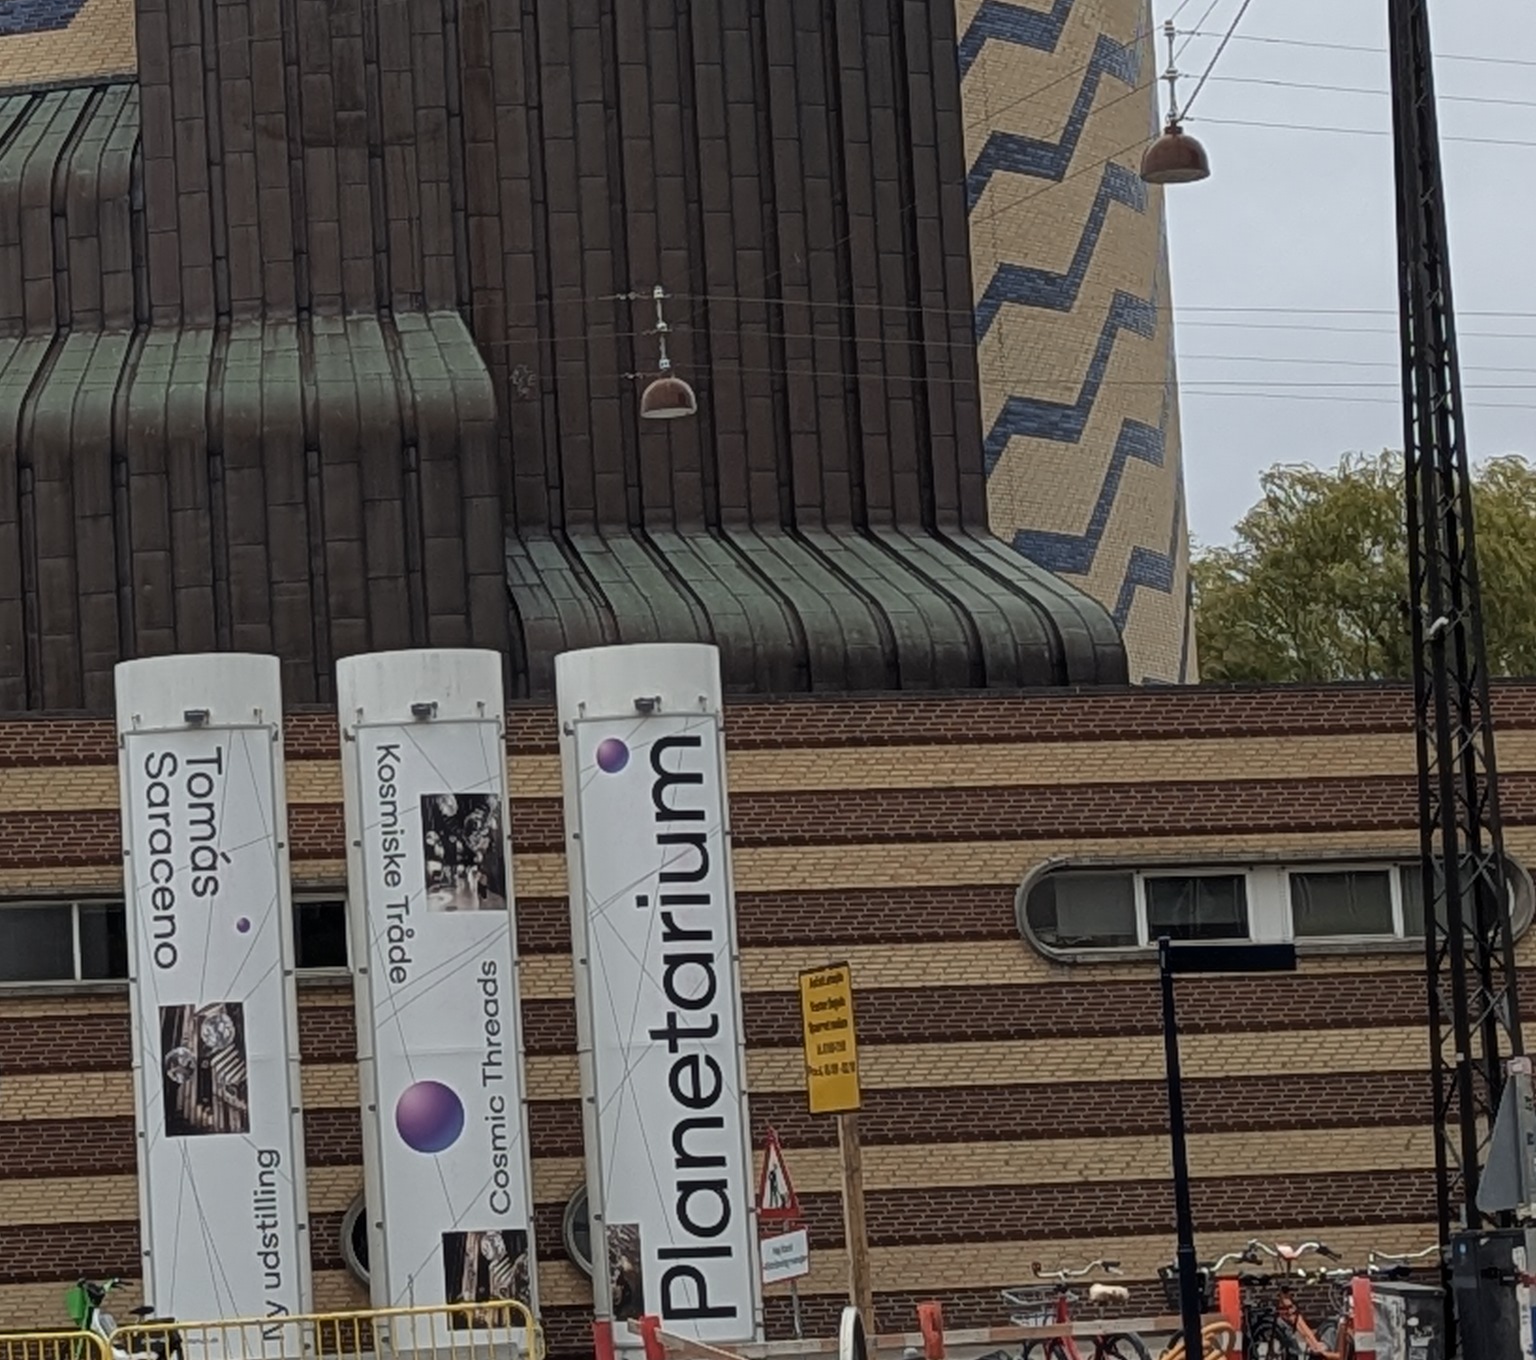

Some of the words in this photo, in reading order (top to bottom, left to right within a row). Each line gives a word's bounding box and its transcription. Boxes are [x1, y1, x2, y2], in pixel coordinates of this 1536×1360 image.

[145, 752, 178, 969] Saraceno
[186, 746, 231, 897] Tomás
[376, 744, 406, 887] Kosmiske
[386, 895, 414, 983] Tråde
[477, 960, 503, 1087] Threads
[638, 734, 738, 1320] Planetarium
[254, 1149, 281, 1290] udstilling
[484, 1095, 511, 1215] Cosmic
